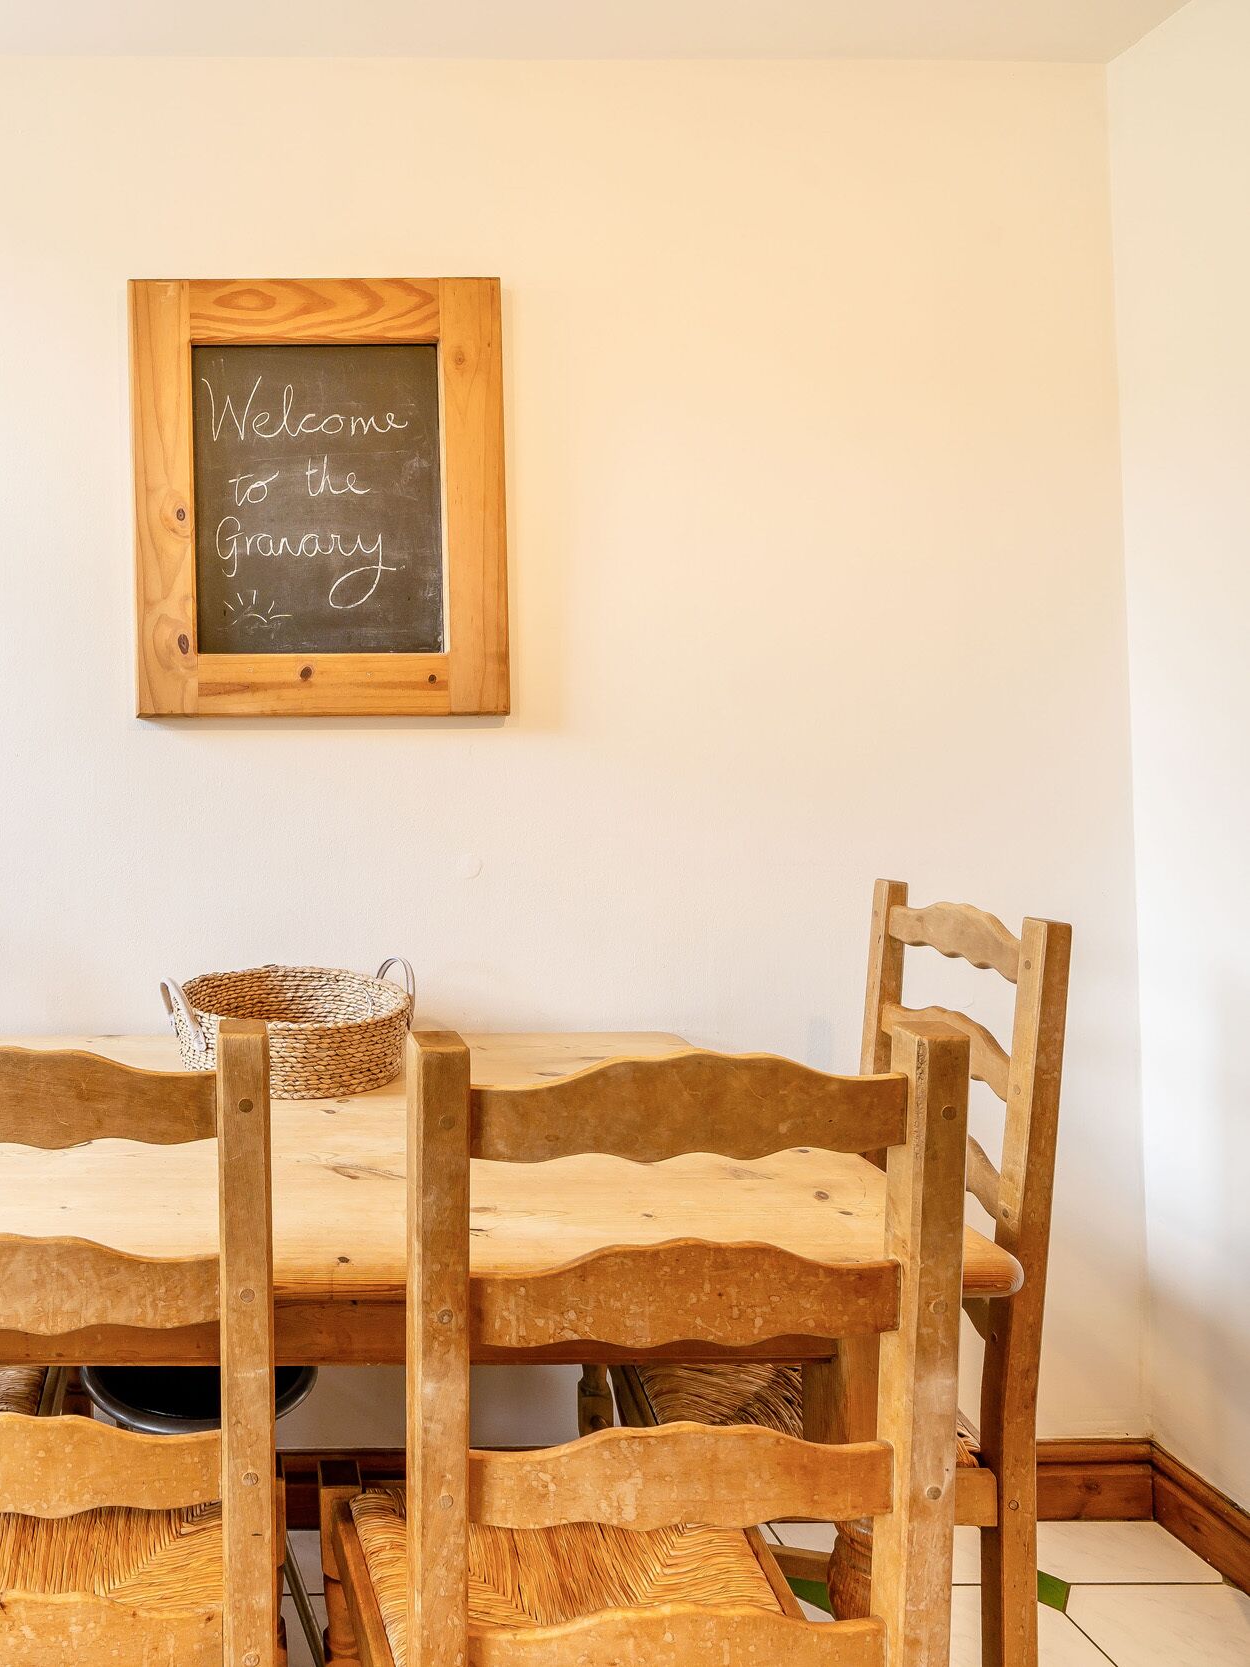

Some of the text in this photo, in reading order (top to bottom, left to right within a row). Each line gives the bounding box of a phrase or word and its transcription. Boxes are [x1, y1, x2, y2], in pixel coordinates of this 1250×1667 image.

[201, 375, 408, 442] Welcome
[228, 454, 372, 507] to the
[215, 515, 397, 610] Granary
